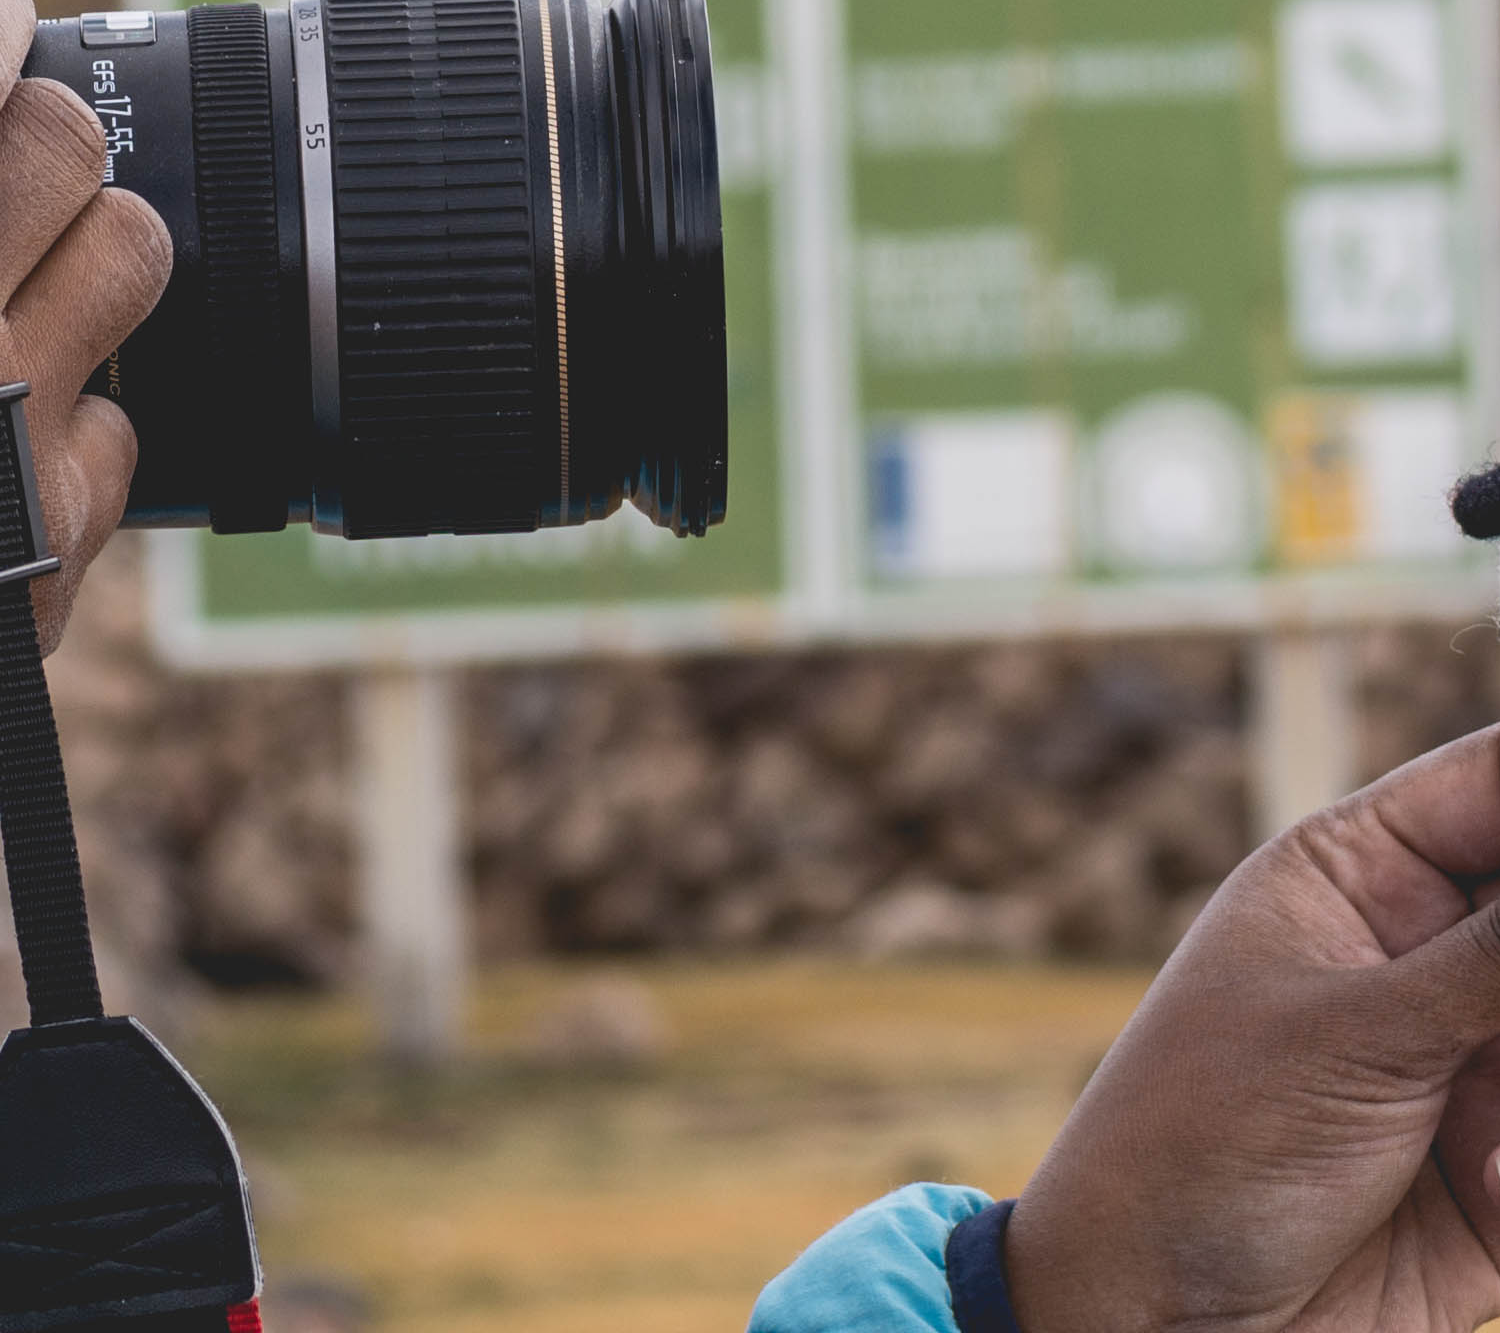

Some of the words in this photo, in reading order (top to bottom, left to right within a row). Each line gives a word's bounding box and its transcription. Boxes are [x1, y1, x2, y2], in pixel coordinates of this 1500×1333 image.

[300, 25, 320, 42] 35
[92, 59, 116, 94] EFS
[305, 123, 326, 150] 55
